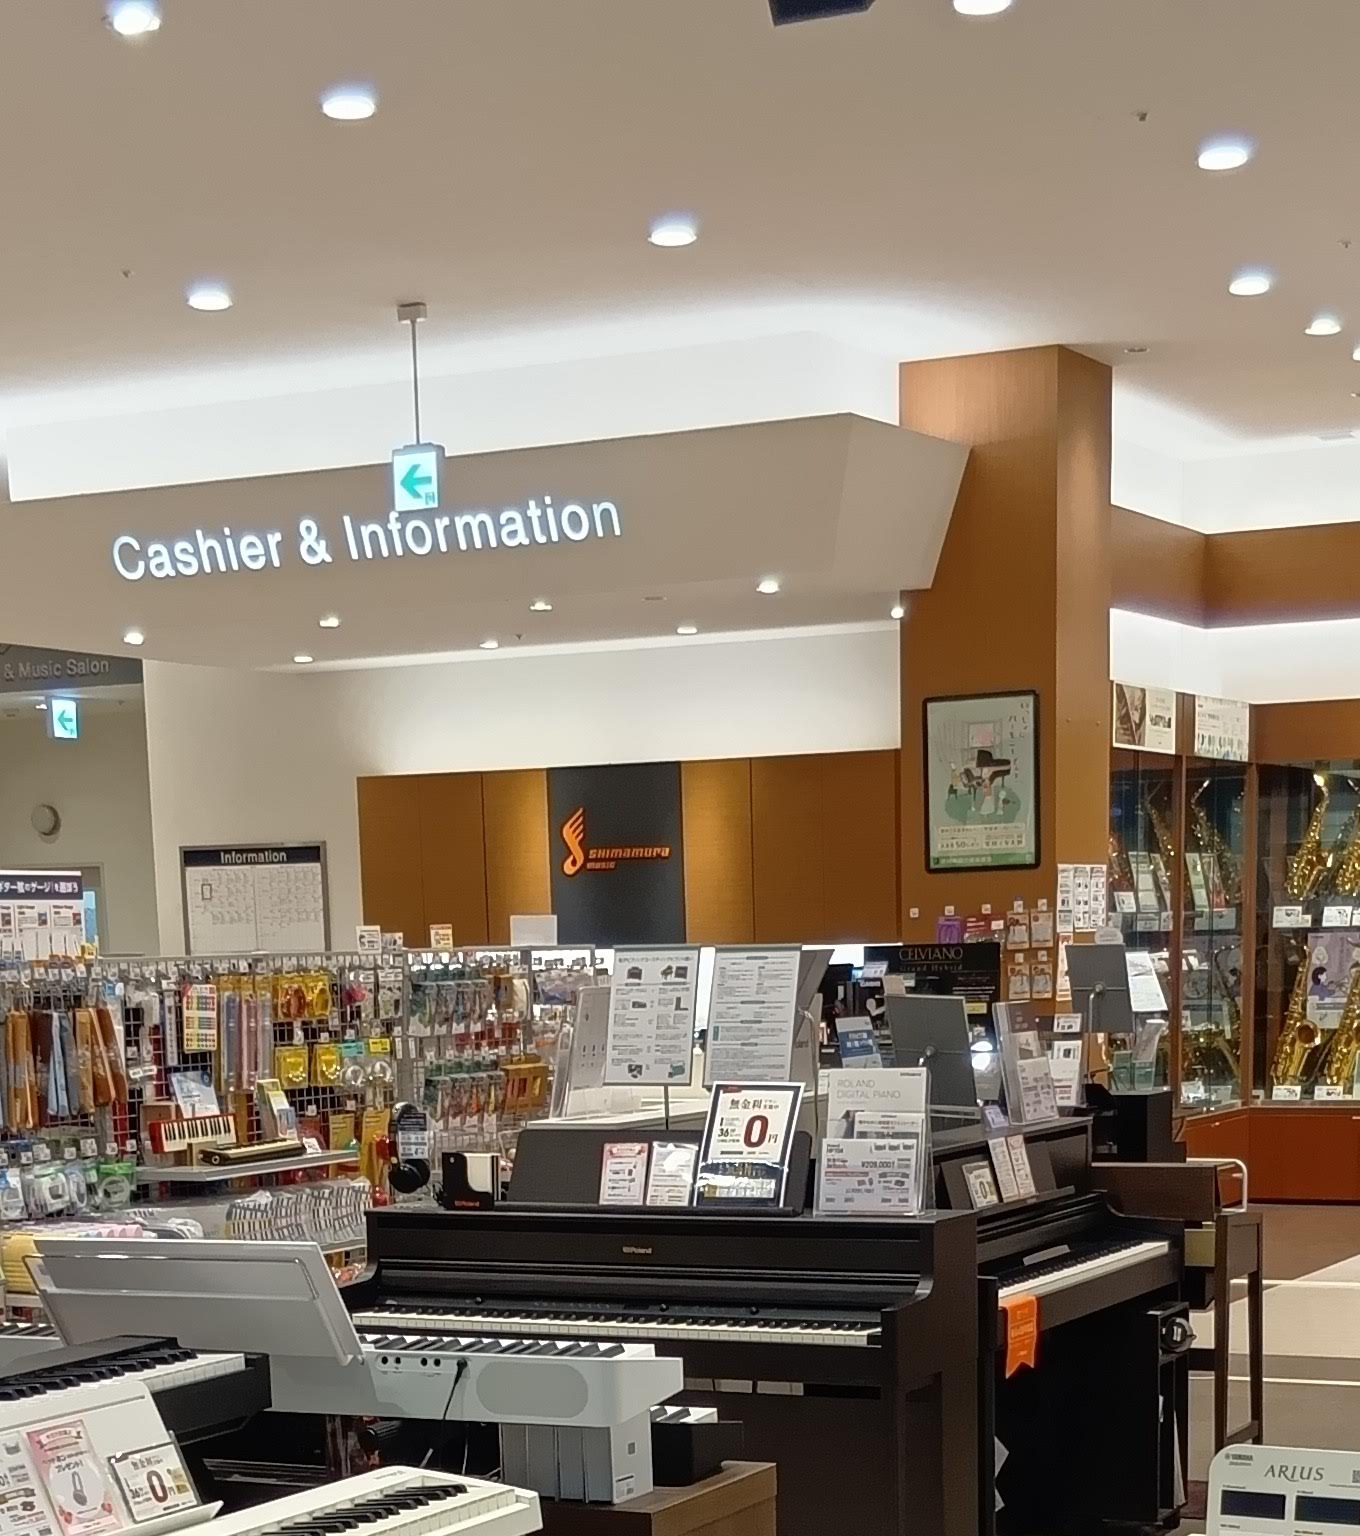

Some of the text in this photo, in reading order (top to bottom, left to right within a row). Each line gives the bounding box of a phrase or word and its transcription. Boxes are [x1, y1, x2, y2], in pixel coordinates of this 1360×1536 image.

[112, 496, 622, 580] Cashier & Information
[4, 664, 15, 680] &
[19, 660, 62, 681] Music
[66, 658, 110, 675] Salon
[220, 850, 287, 864] Information
[899, 947, 963, 961] CELVIANO
[743, 1114, 769, 1149] 0
[1264, 1464, 1325, 1483] ARIUS
[146, 1470, 169, 1503] 0
